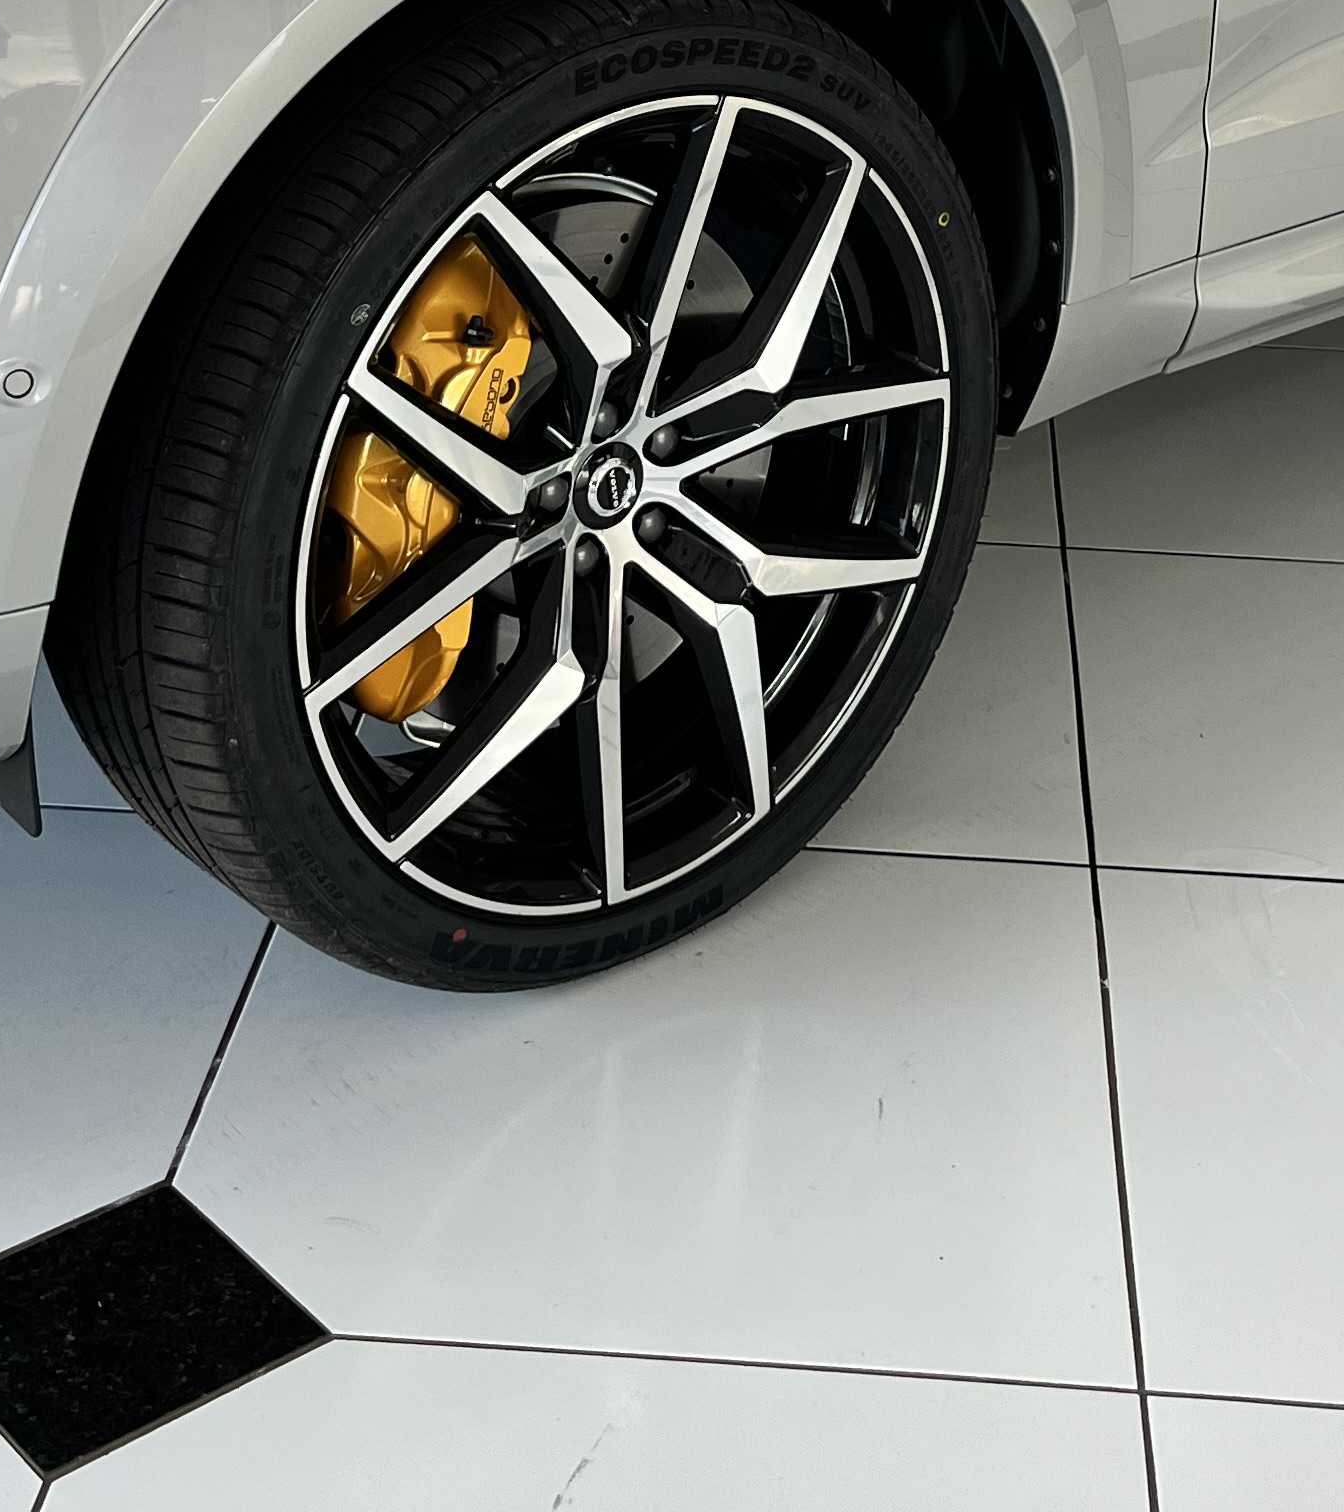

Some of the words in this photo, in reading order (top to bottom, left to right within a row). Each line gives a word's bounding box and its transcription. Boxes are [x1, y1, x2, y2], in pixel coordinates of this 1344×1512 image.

[573, 38, 816, 96] ECOSPEED2
[818, 73, 874, 110] SUV
[609, 469, 619, 508] VOLVO
